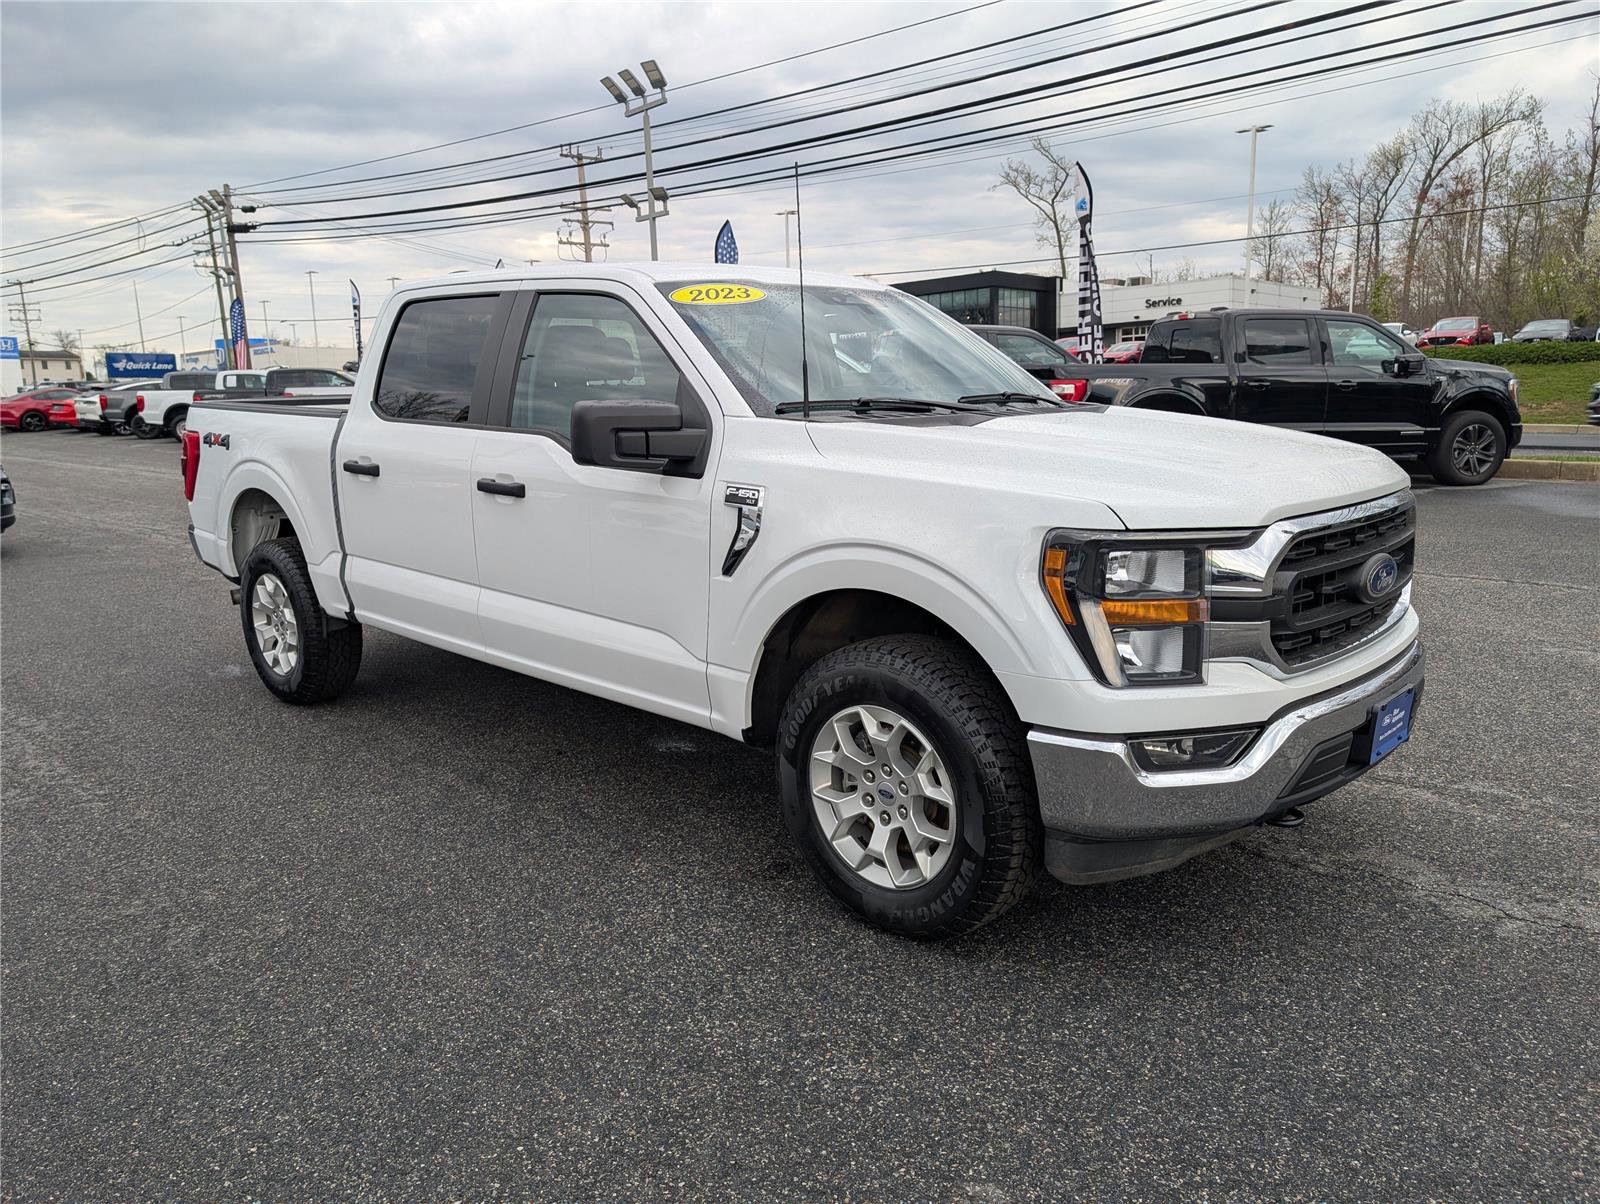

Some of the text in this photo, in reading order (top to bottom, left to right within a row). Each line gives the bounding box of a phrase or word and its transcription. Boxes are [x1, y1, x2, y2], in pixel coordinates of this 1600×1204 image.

[689, 287, 751, 302] 2023
[1145, 296, 1182, 309] Service
[126, 361, 174, 371] Quick Lane
[726, 487, 759, 499] F-150
